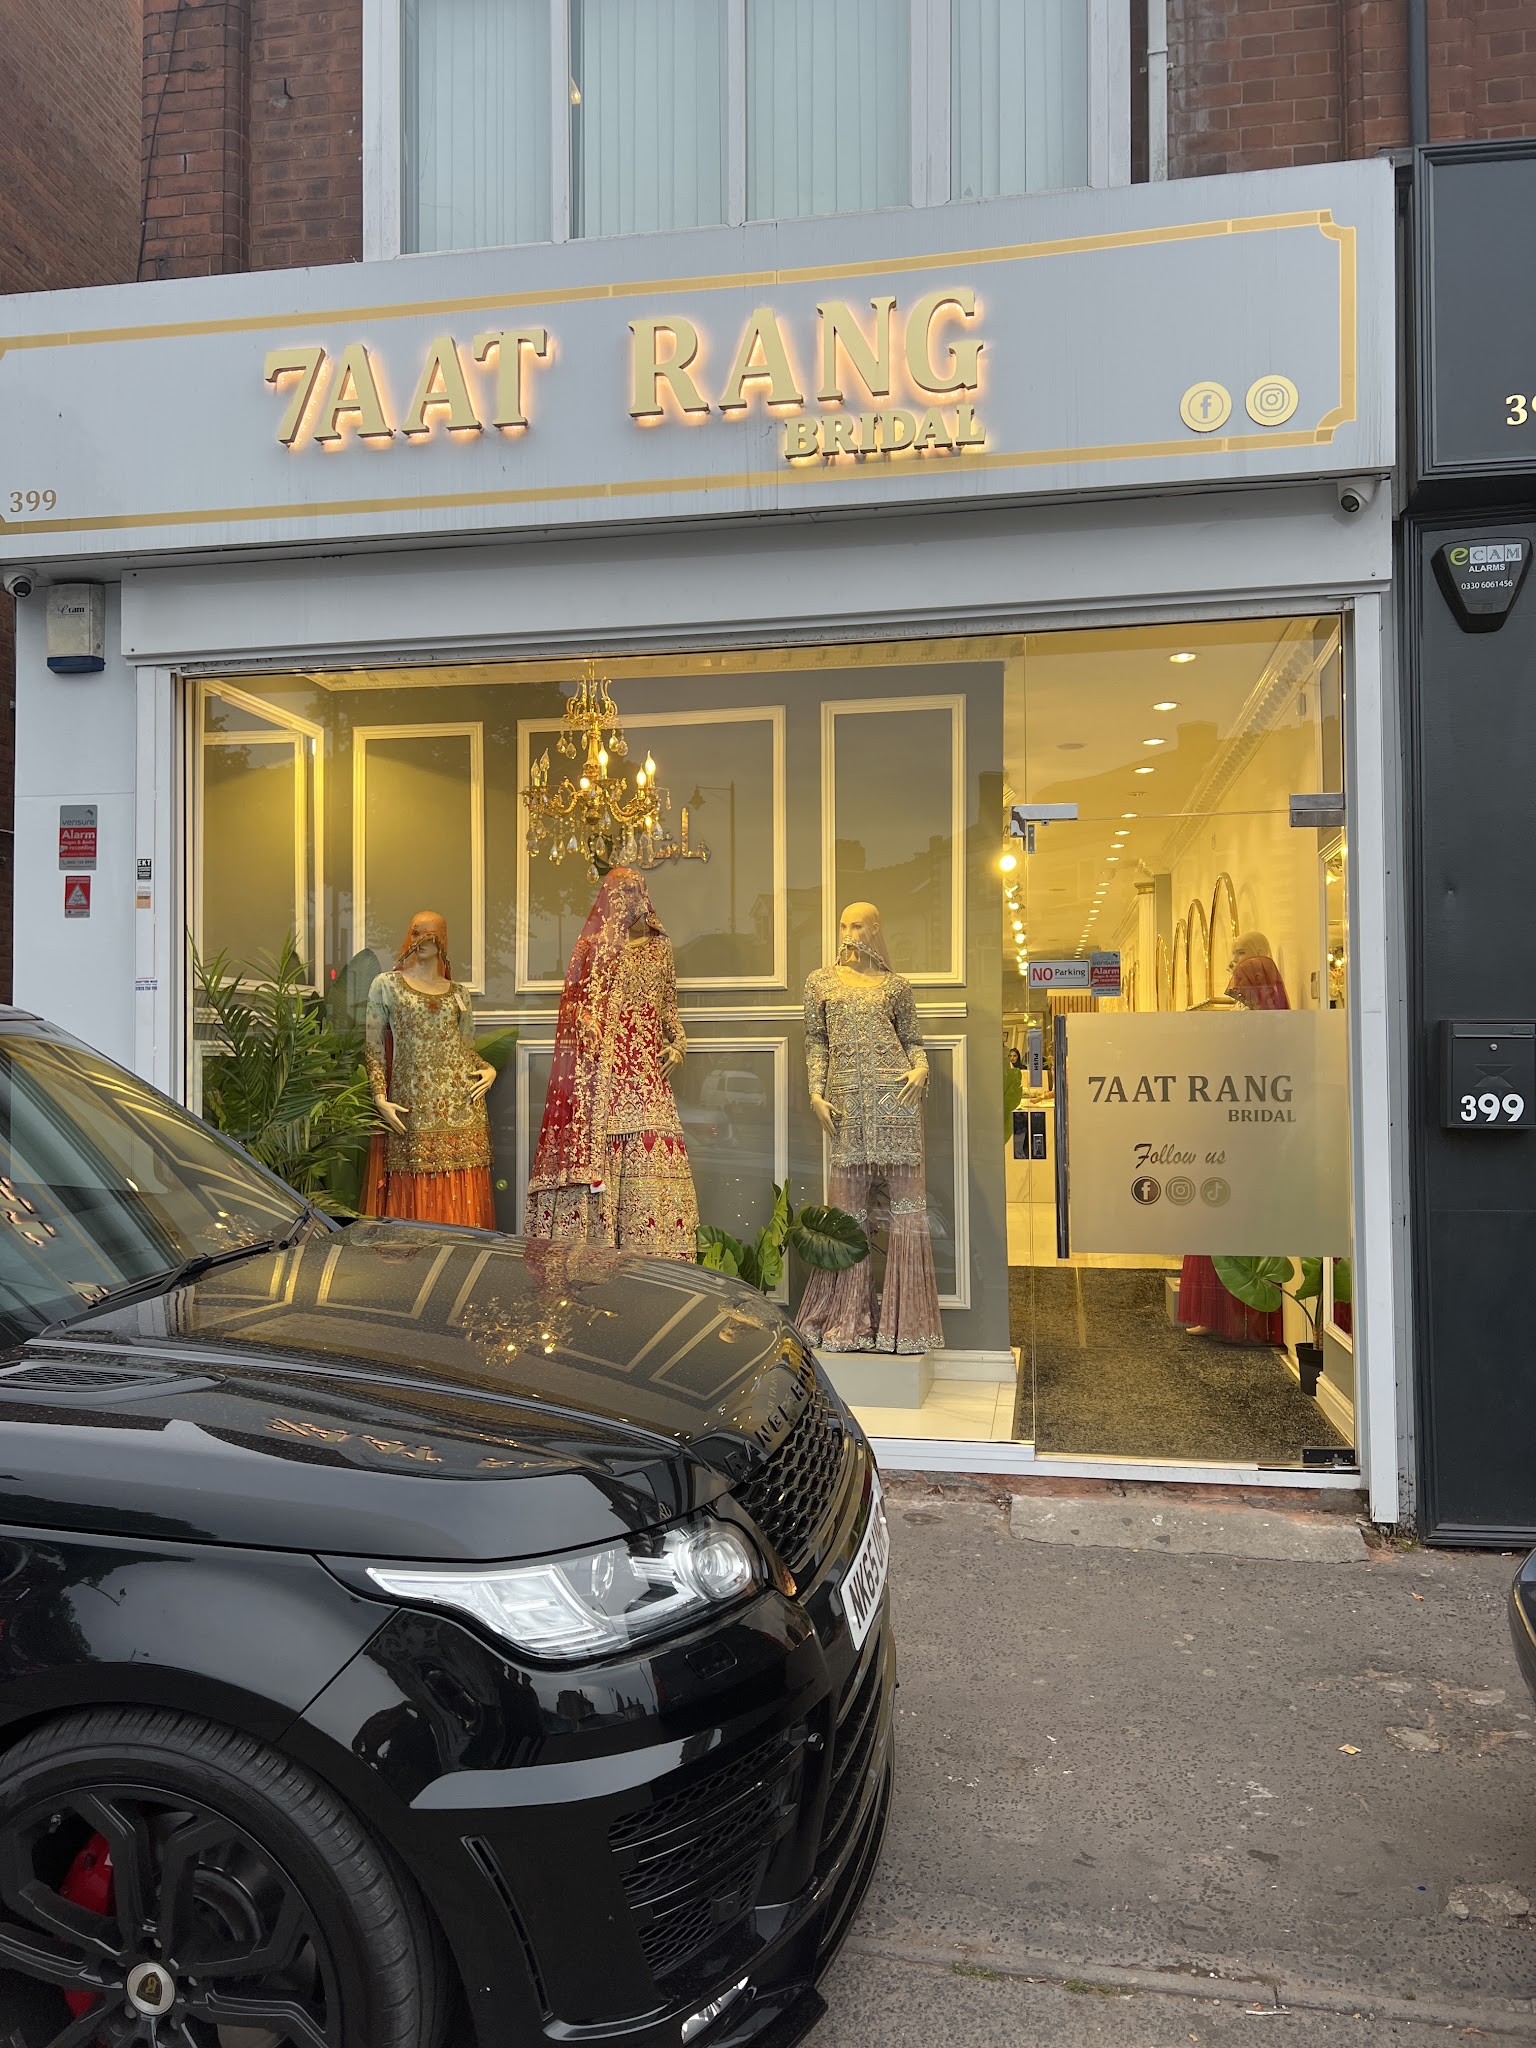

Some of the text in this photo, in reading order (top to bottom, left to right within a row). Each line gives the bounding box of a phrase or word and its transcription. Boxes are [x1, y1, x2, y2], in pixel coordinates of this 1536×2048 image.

[264, 289, 984, 446] 7AAT RANG
[1505, 394, 1536, 426] 3
[784, 404, 986, 459] BRIDAL
[10, 490, 57, 512] 399
[1469, 563, 1506, 573] ALARMS
[1461, 580, 1513, 590] 0330 6061456
[62, 829, 95, 839] Alarm
[1032, 968, 1086, 980] NO Parking
[1088, 1075, 1294, 1103] 7AAT RANG
[1228, 1109, 1297, 1122] BRIDAL
[1461, 1093, 1525, 1122] 399
[1134, 1143, 1227, 1169] Follow us
